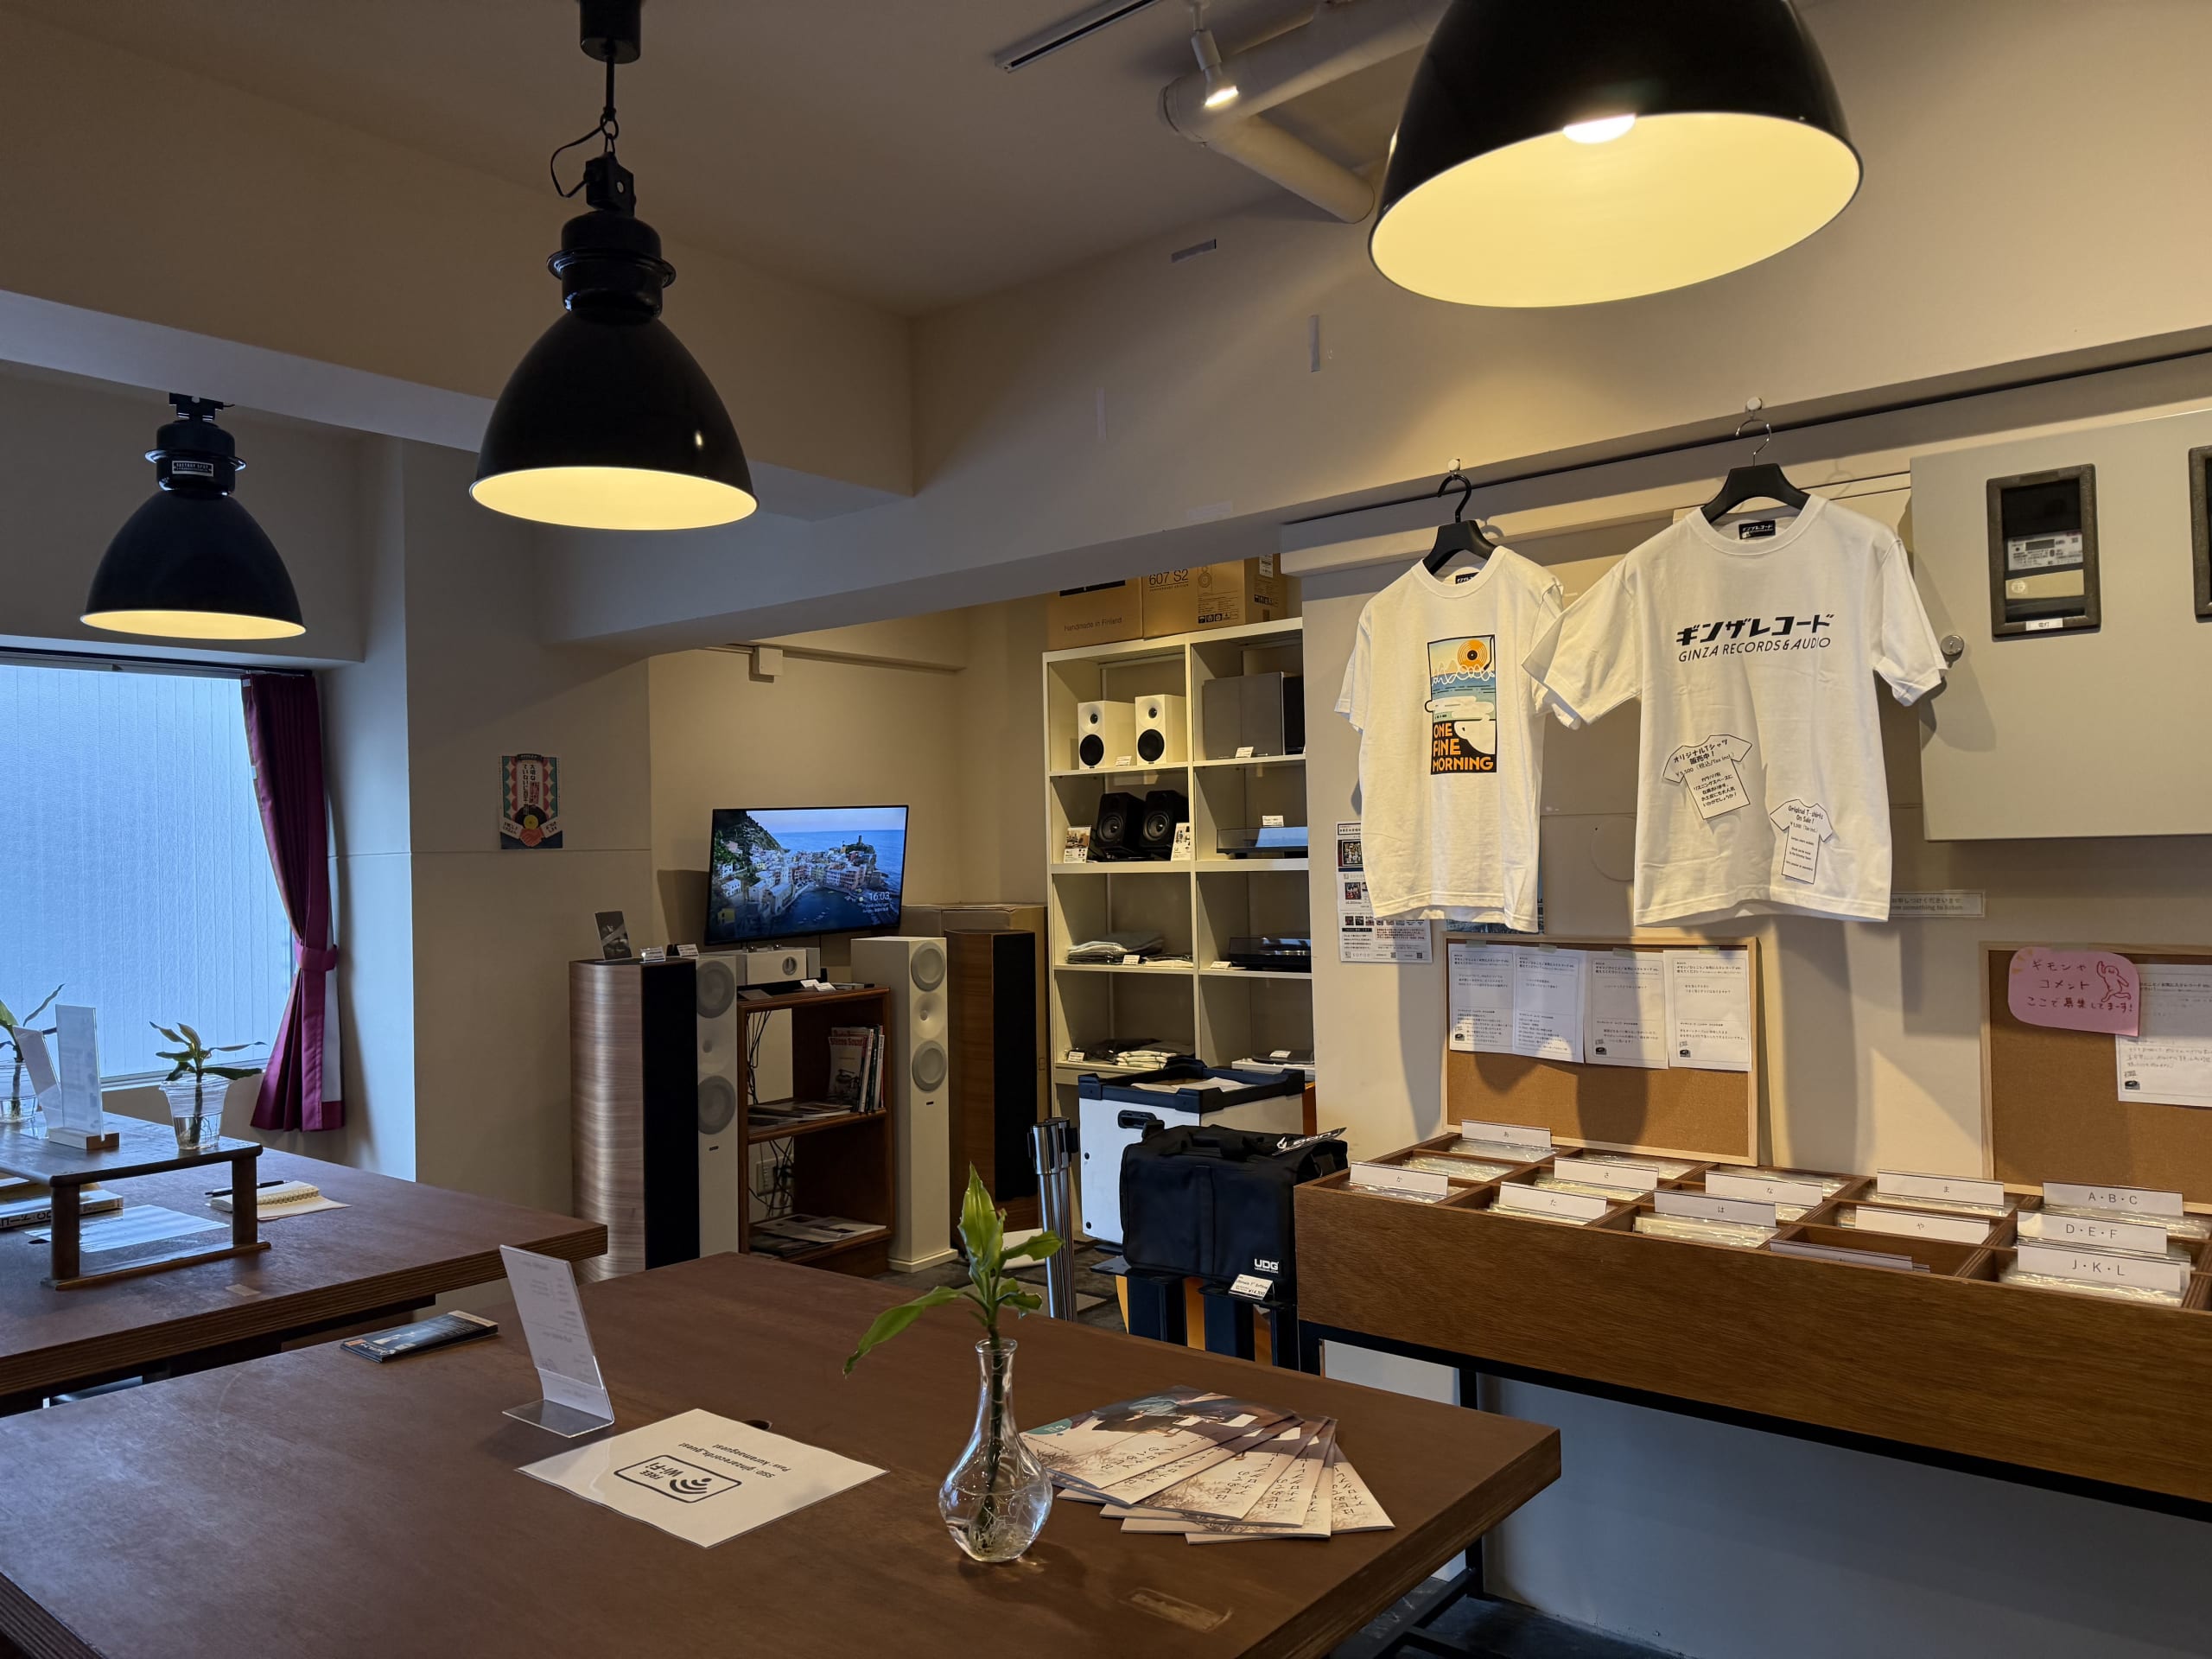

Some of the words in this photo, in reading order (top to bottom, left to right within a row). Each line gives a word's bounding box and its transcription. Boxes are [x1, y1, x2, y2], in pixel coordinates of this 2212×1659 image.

[1148, 571, 1169, 586] 607
[1173, 569, 1189, 583] S2
[1064, 621, 1094, 632] Handmade
[1102, 617, 1122, 626] Finland
[1676, 613, 1834, 646] ギンザレコード
[1679, 645, 1719, 663] GINZA
[1722, 639, 1781, 656] RECORDS
[1790, 637, 1831, 650] AUDIO
[1433, 722, 1453, 739] ONE
[1433, 738, 1462, 758] FINE
[1433, 756, 1494, 772] MORNING
[868, 892, 890, 901] 16:03
[2032, 959, 2088, 971] ギモンや
[2039, 979, 2089, 989] コメント
[1254, 1258, 1278, 1270] UDG
[639, 1470, 664, 1480] FREE
[645, 1462, 683, 1477] Wi-Fi
